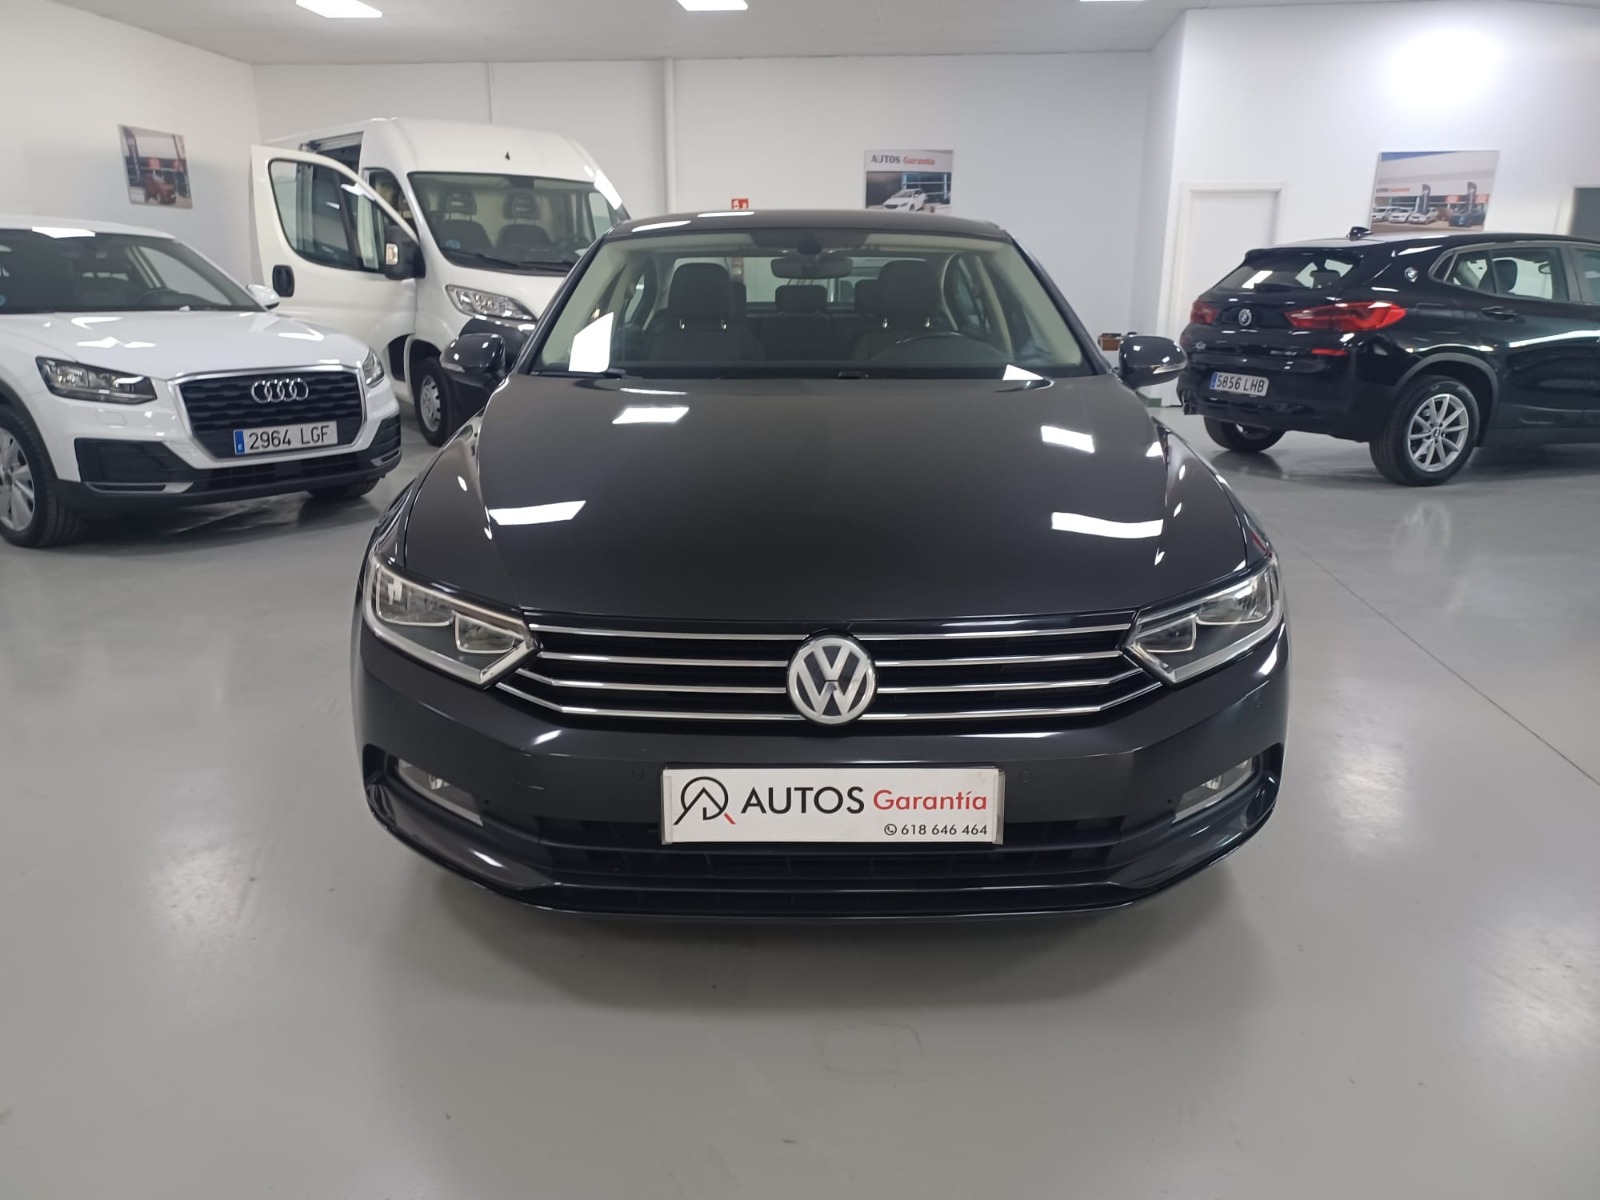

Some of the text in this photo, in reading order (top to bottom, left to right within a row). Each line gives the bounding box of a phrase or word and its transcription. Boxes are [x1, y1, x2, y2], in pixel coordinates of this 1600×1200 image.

[871, 155, 901, 164] AUTOS
[1216, 375, 1265, 393] 5856 LHB
[248, 425, 330, 450] 2964 LGF
[740, 786, 988, 814] AUTOS Garantía
[900, 824, 988, 836] 618 646 464
